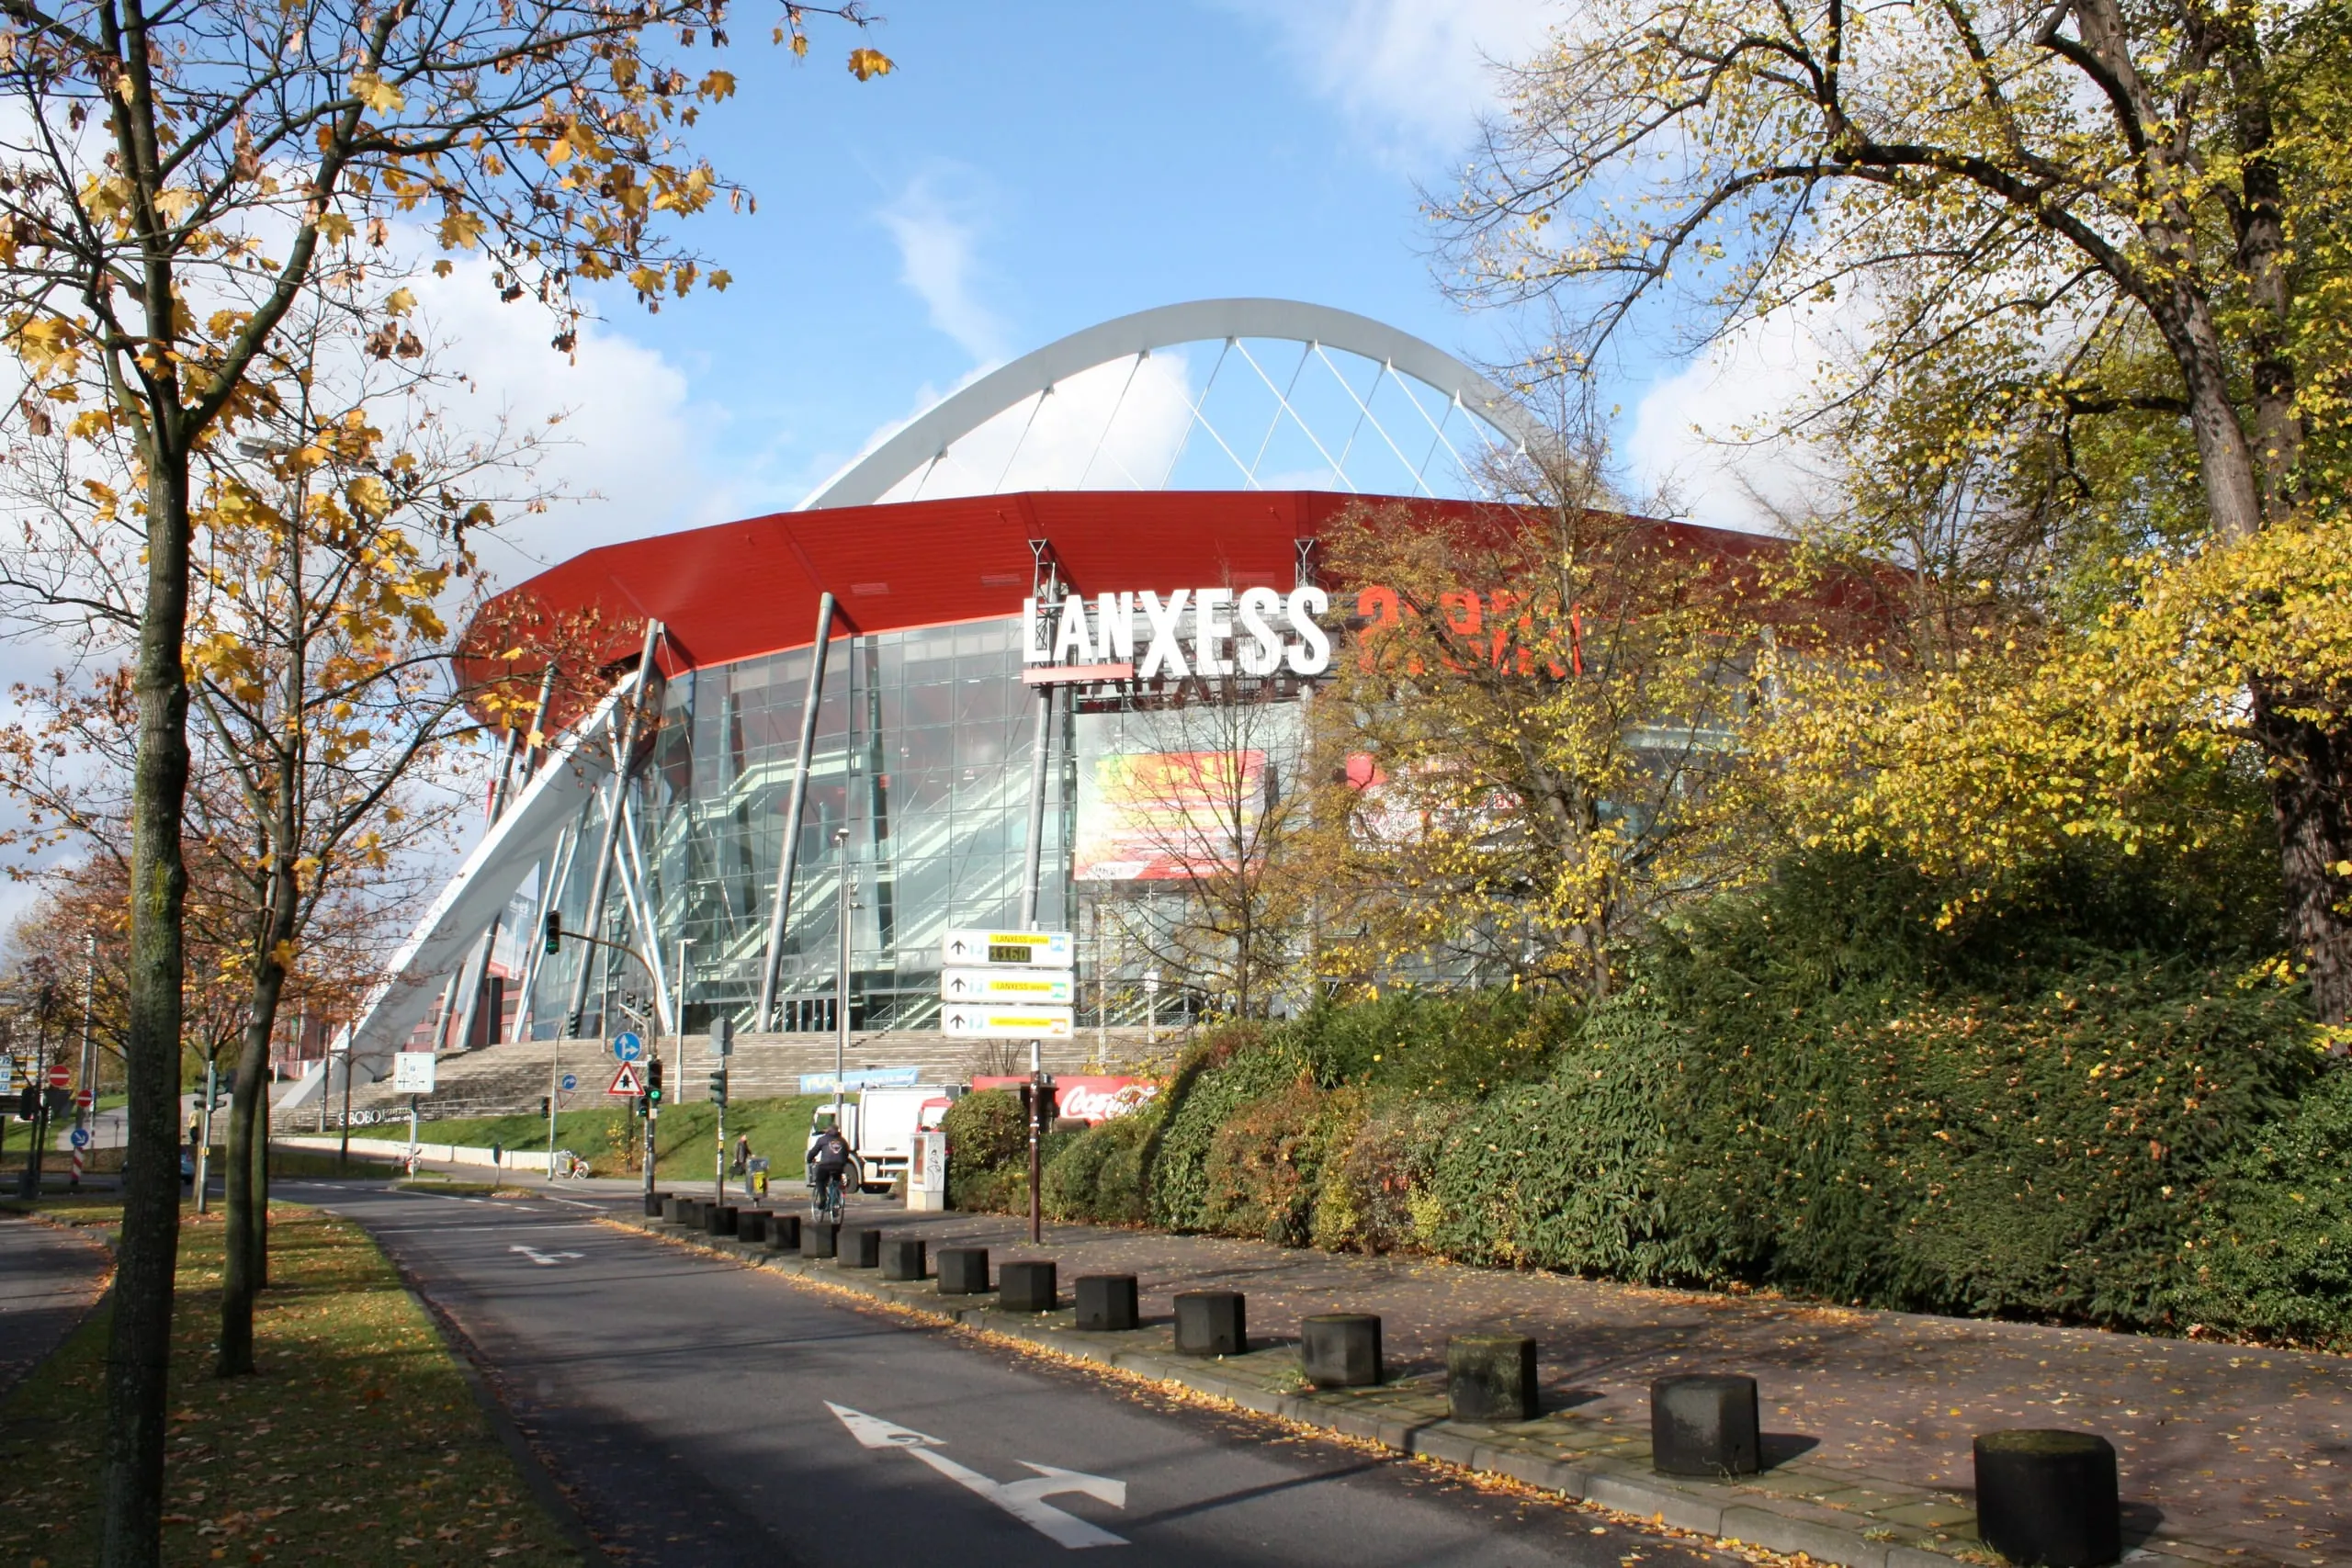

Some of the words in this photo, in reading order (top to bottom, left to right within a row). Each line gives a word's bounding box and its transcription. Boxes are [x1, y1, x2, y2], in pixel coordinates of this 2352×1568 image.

[1023, 586, 1329, 677] LANXESS
[995, 935, 1028, 943] LANXESS
[996, 982, 1029, 991] LANXESS
[1060, 1085, 1159, 1122] Coca-Col
